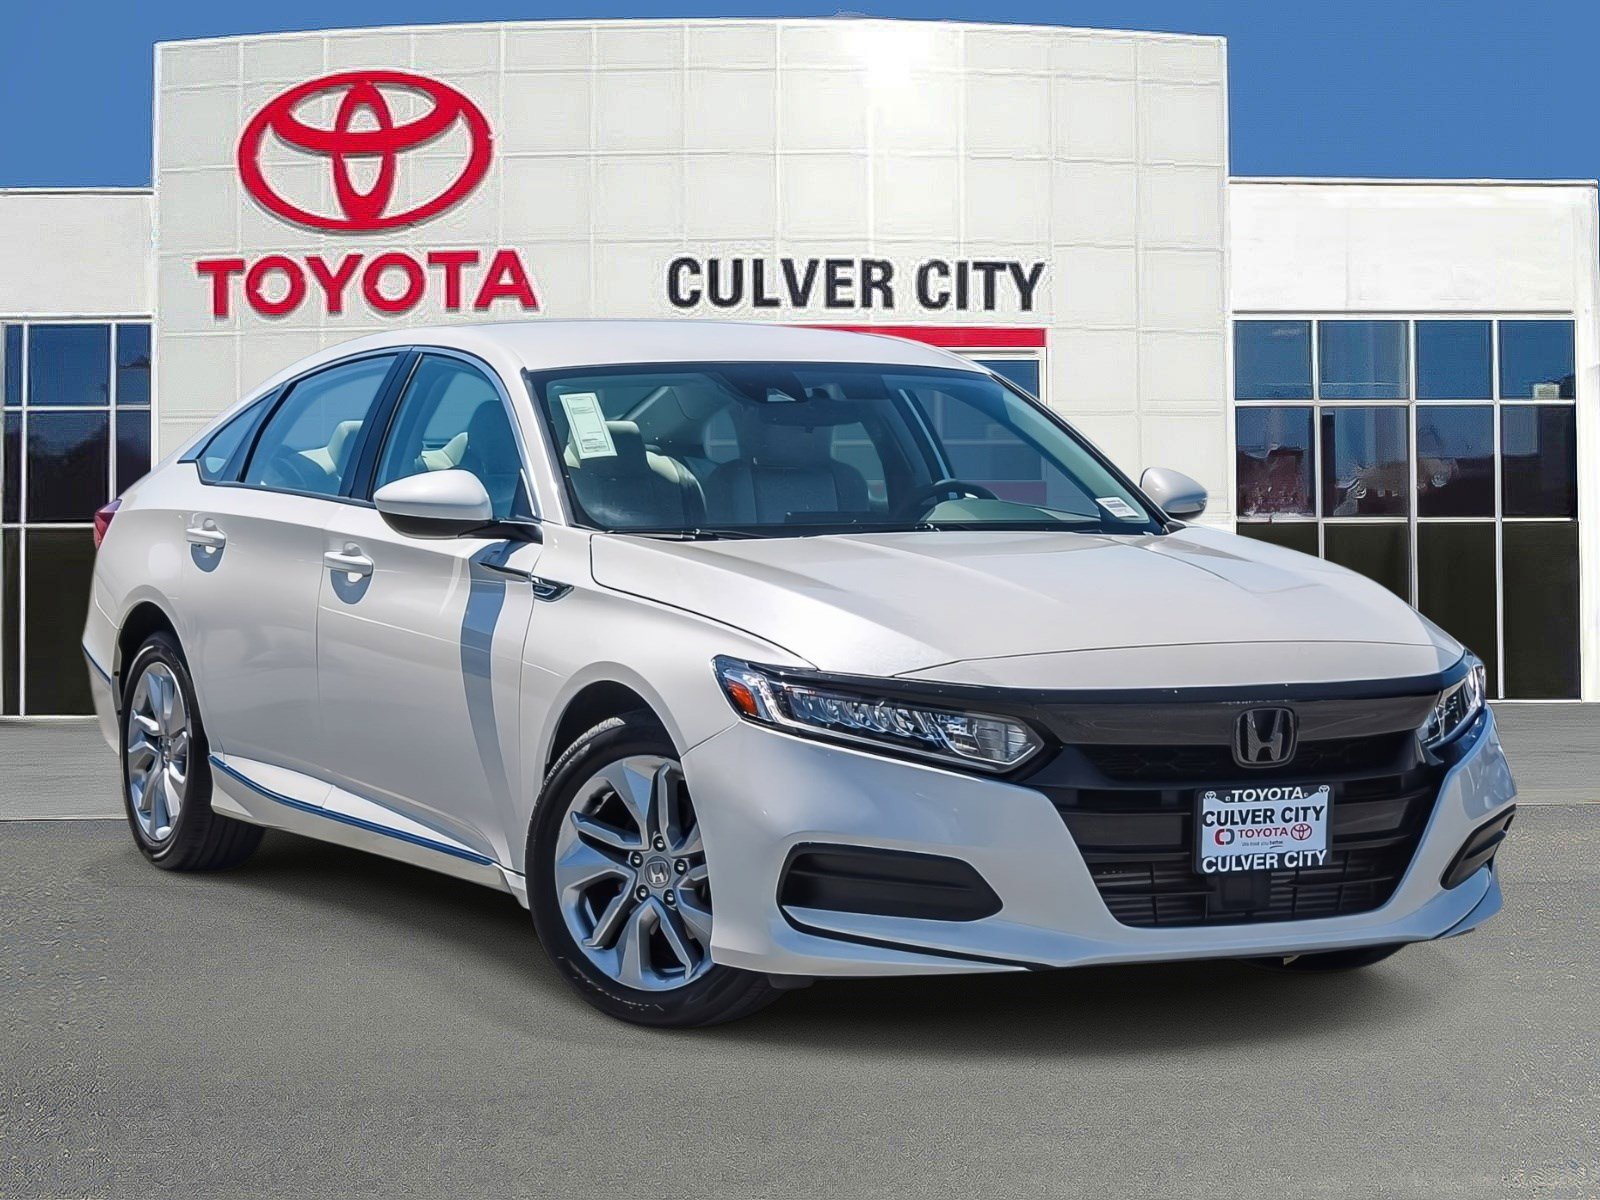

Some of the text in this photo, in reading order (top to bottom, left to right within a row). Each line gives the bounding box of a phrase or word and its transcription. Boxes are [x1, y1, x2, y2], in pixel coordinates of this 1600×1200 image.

[195, 250, 539, 316] TOYOTA
[668, 257, 1045, 311] CULVER CITY
[1231, 787, 1303, 802] TOYOTA
[1202, 805, 1325, 827] CULVER CITY
[1238, 827, 1288, 838] TOYOTA
[1202, 849, 1327, 873] CULVER CITY
